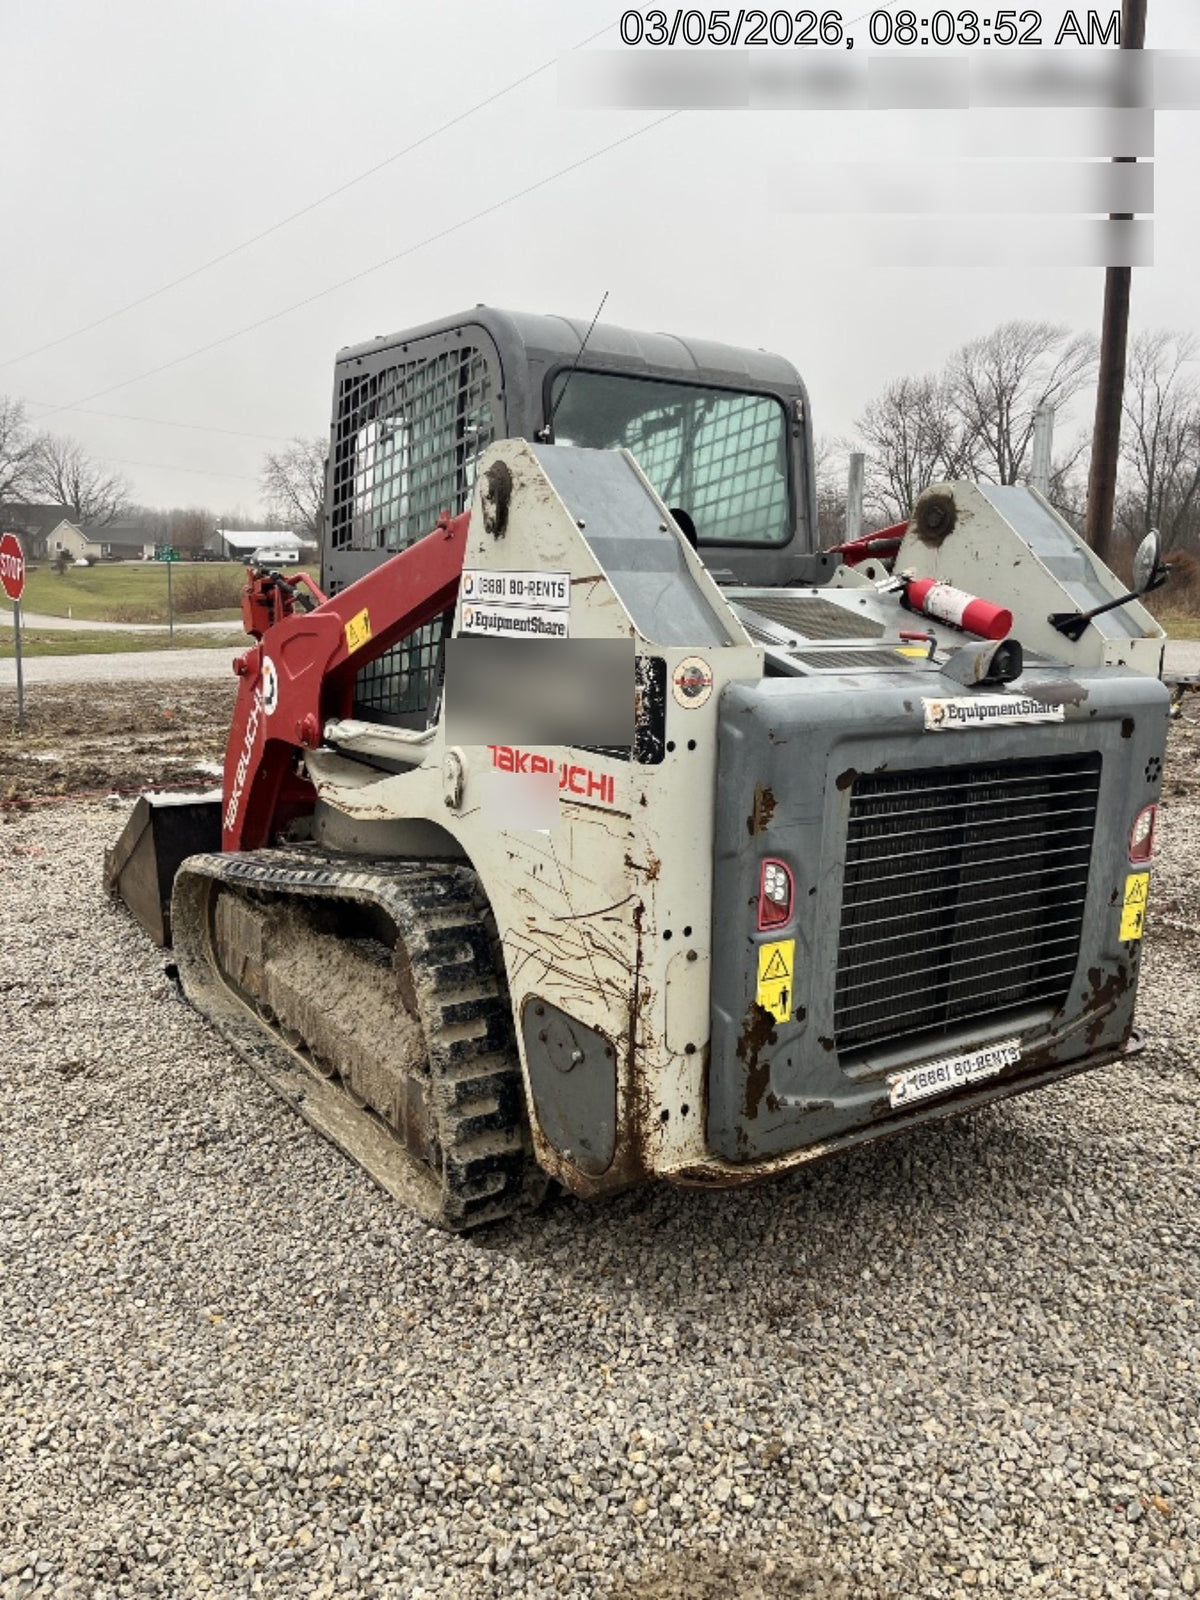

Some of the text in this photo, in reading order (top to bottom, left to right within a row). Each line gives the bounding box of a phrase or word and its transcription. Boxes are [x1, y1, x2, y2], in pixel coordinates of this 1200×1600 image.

[0, 553, 22, 581] STOP
[475, 611, 565, 635] EquipmentShare
[948, 700, 1059, 721] EquipmentShare
